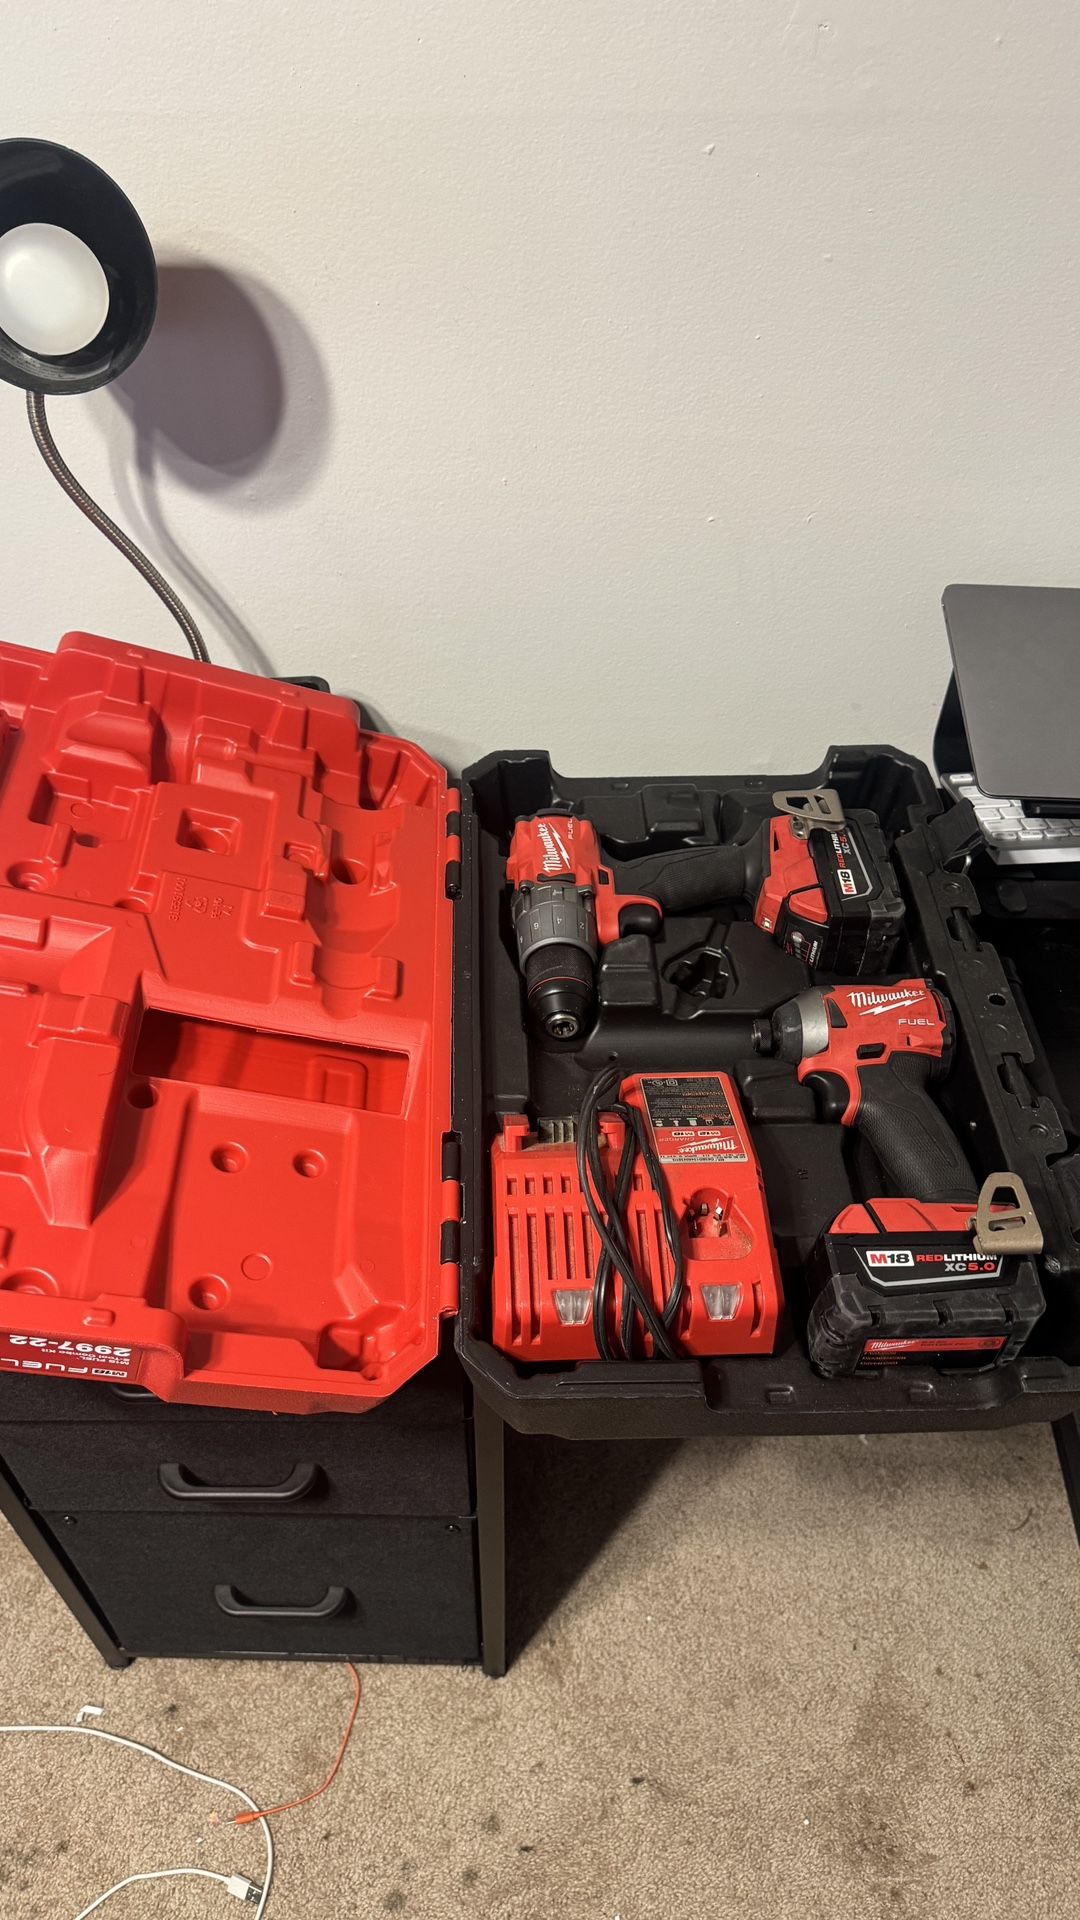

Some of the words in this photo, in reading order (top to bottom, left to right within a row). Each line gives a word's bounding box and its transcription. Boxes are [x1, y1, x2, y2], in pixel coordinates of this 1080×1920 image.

[537, 823, 563, 873] Milwaukee
[831, 832, 847, 868] REDLITHIU
[840, 871, 855, 893] M18
[846, 988, 926, 1008] Milwaukee
[898, 1018, 935, 1026] FUEL
[678, 1139, 738, 1154] Milwaukee
[869, 1253, 910, 1264] M18
[915, 1253, 998, 1262] REDLITHIUM
[9, 1334, 132, 1357] 2997-22
[871, 1339, 916, 1350] Milwaukee
[58, 1350, 97, 1358] Combo
[0, 1357, 89, 1374] FUEL
[93, 1368, 126, 1377] M18
